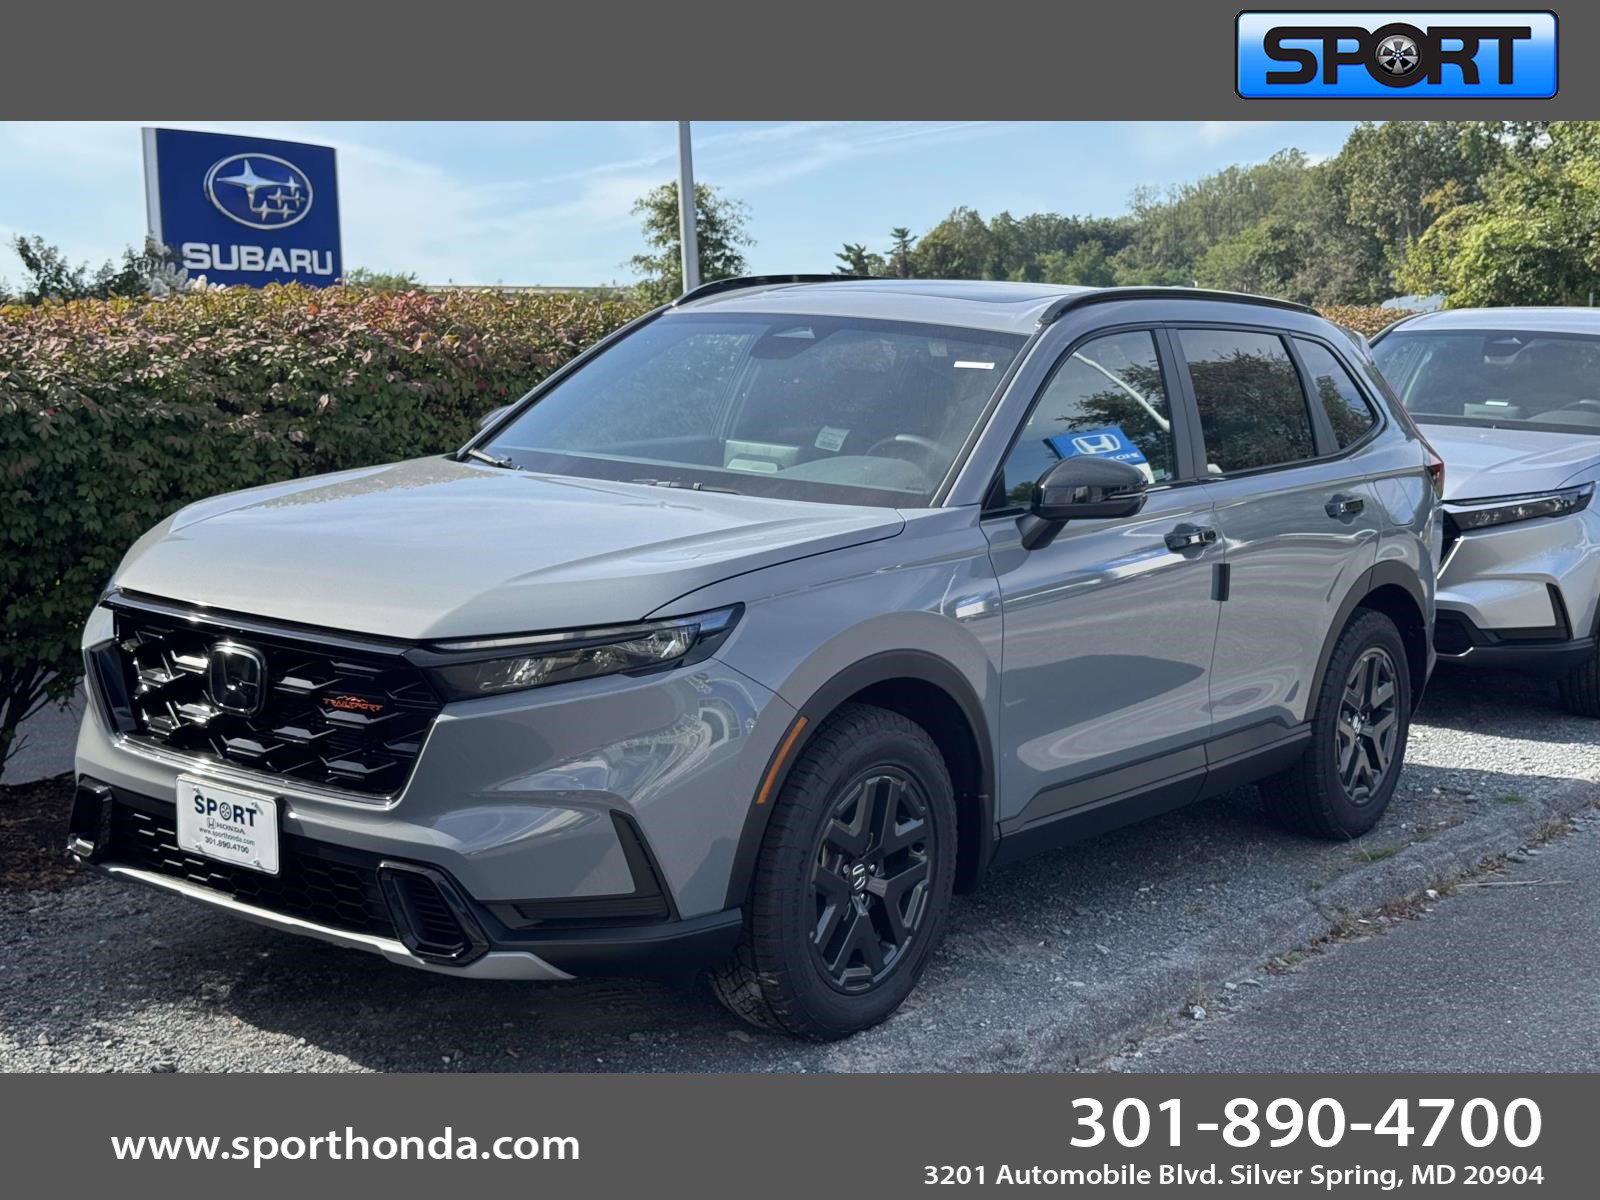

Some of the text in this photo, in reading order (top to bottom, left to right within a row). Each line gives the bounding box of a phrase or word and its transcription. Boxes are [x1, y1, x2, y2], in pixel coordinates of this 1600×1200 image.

[182, 242, 333, 275] SUBARU
[322, 697, 383, 712] TRAILSPORT
[194, 794, 257, 827] SPORT
[216, 822, 246, 835] HONDA
[205, 836, 249, 854] 301.890.4700
